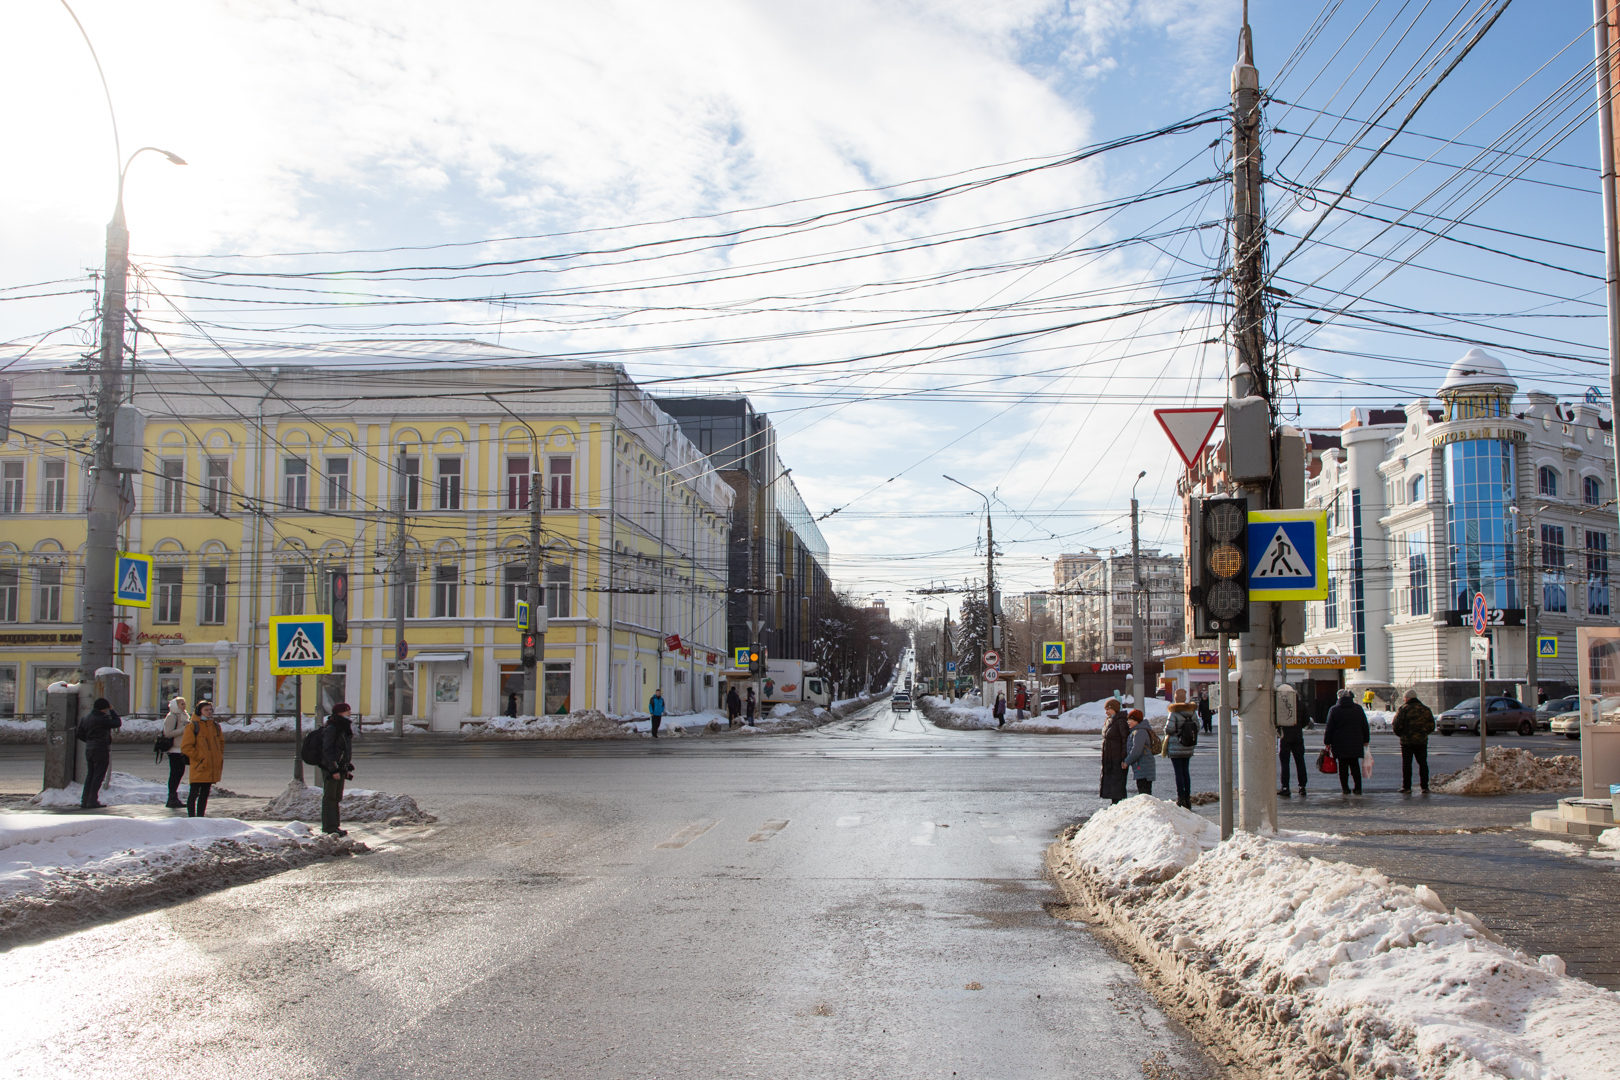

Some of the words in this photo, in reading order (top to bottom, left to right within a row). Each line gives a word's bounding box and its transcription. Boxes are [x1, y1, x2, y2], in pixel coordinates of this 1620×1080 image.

[1431, 427, 1492, 447] ТОРГОВЫЙ
[1497, 428, 1528, 441] ЦЕНТР
[1460, 609, 1505, 626] TEE2
[1309, 657, 1346, 665] ОБЛАСТИ
[1101, 663, 1132, 672] ДОНЕР
[987, 671, 996, 679] 40
